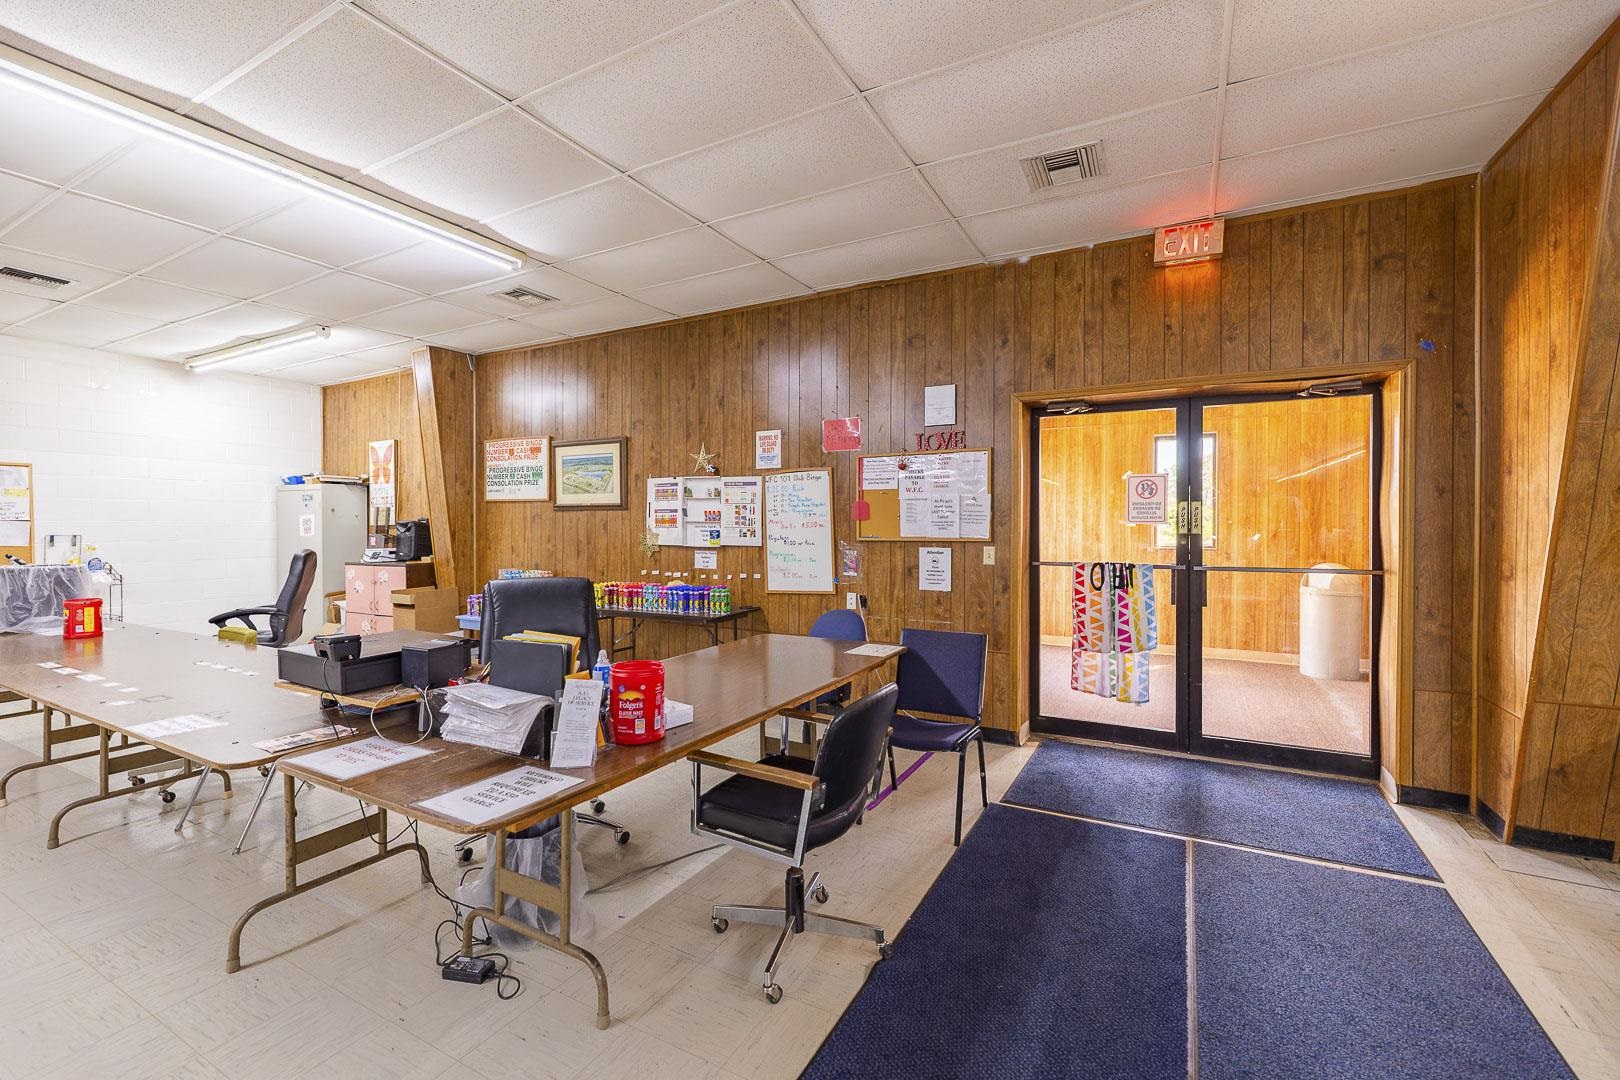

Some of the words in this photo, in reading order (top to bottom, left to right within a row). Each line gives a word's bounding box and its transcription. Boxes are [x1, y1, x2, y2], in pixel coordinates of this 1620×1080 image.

[1164, 221, 1214, 256] EXIT
[489, 441, 525, 449] PROGRESSIVE
[914, 430, 966, 451] LOVE
[486, 454, 523, 462] CONSOLATION
[807, 473, 822, 482] Bingo
[618, 701, 644, 710] Folgers
[520, 775, 549, 785] CHECKS
[526, 770, 565, 782] RETURNED
[514, 780, 534, 788] WILL
[463, 796, 495, 808] CHARGE
